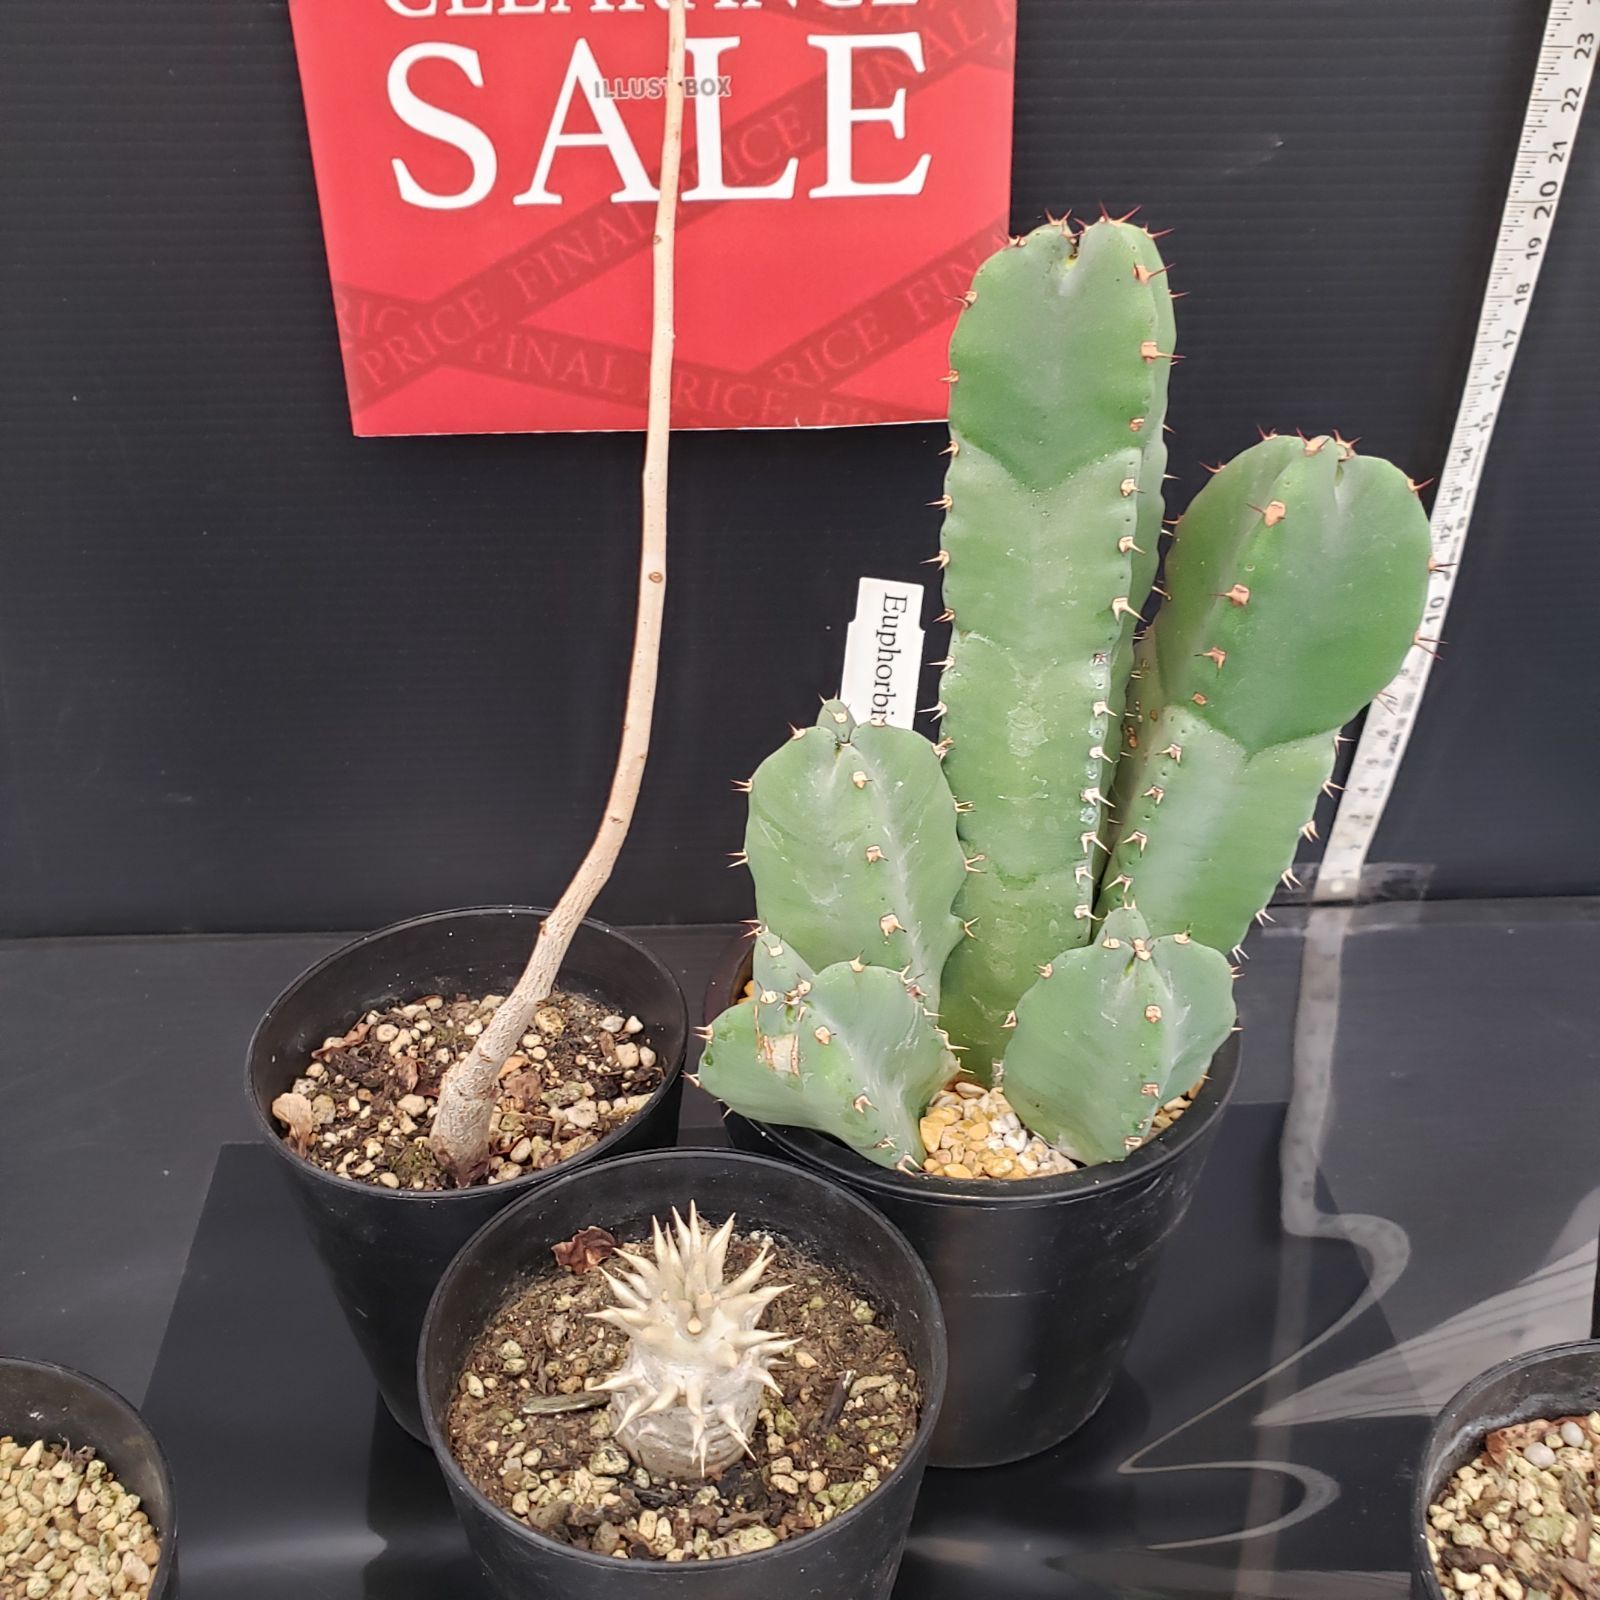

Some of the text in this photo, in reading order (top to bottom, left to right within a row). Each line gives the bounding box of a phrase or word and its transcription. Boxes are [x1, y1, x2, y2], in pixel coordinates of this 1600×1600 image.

[1574, 33, 1594, 59] 23
[594, 77, 731, 98] ILLUS BOX
[1561, 87, 1582, 112] 22
[386, 32, 932, 210] SALE
[1549, 141, 1568, 163] 21
[1533, 181, 1558, 219] 20
[1525, 237, 1542, 260] 19
[1514, 283, 1530, 305] 18
[361, 288, 499, 386] PRICE
[1502, 329, 1517, 349] 17
[774, 312, 888, 389] RICE
[1491, 370, 1506, 391] 16
[674, 368, 789, 425] RICE
[1425, 596, 1445, 624] 10
[871, 592, 907, 718] Euphorbi
